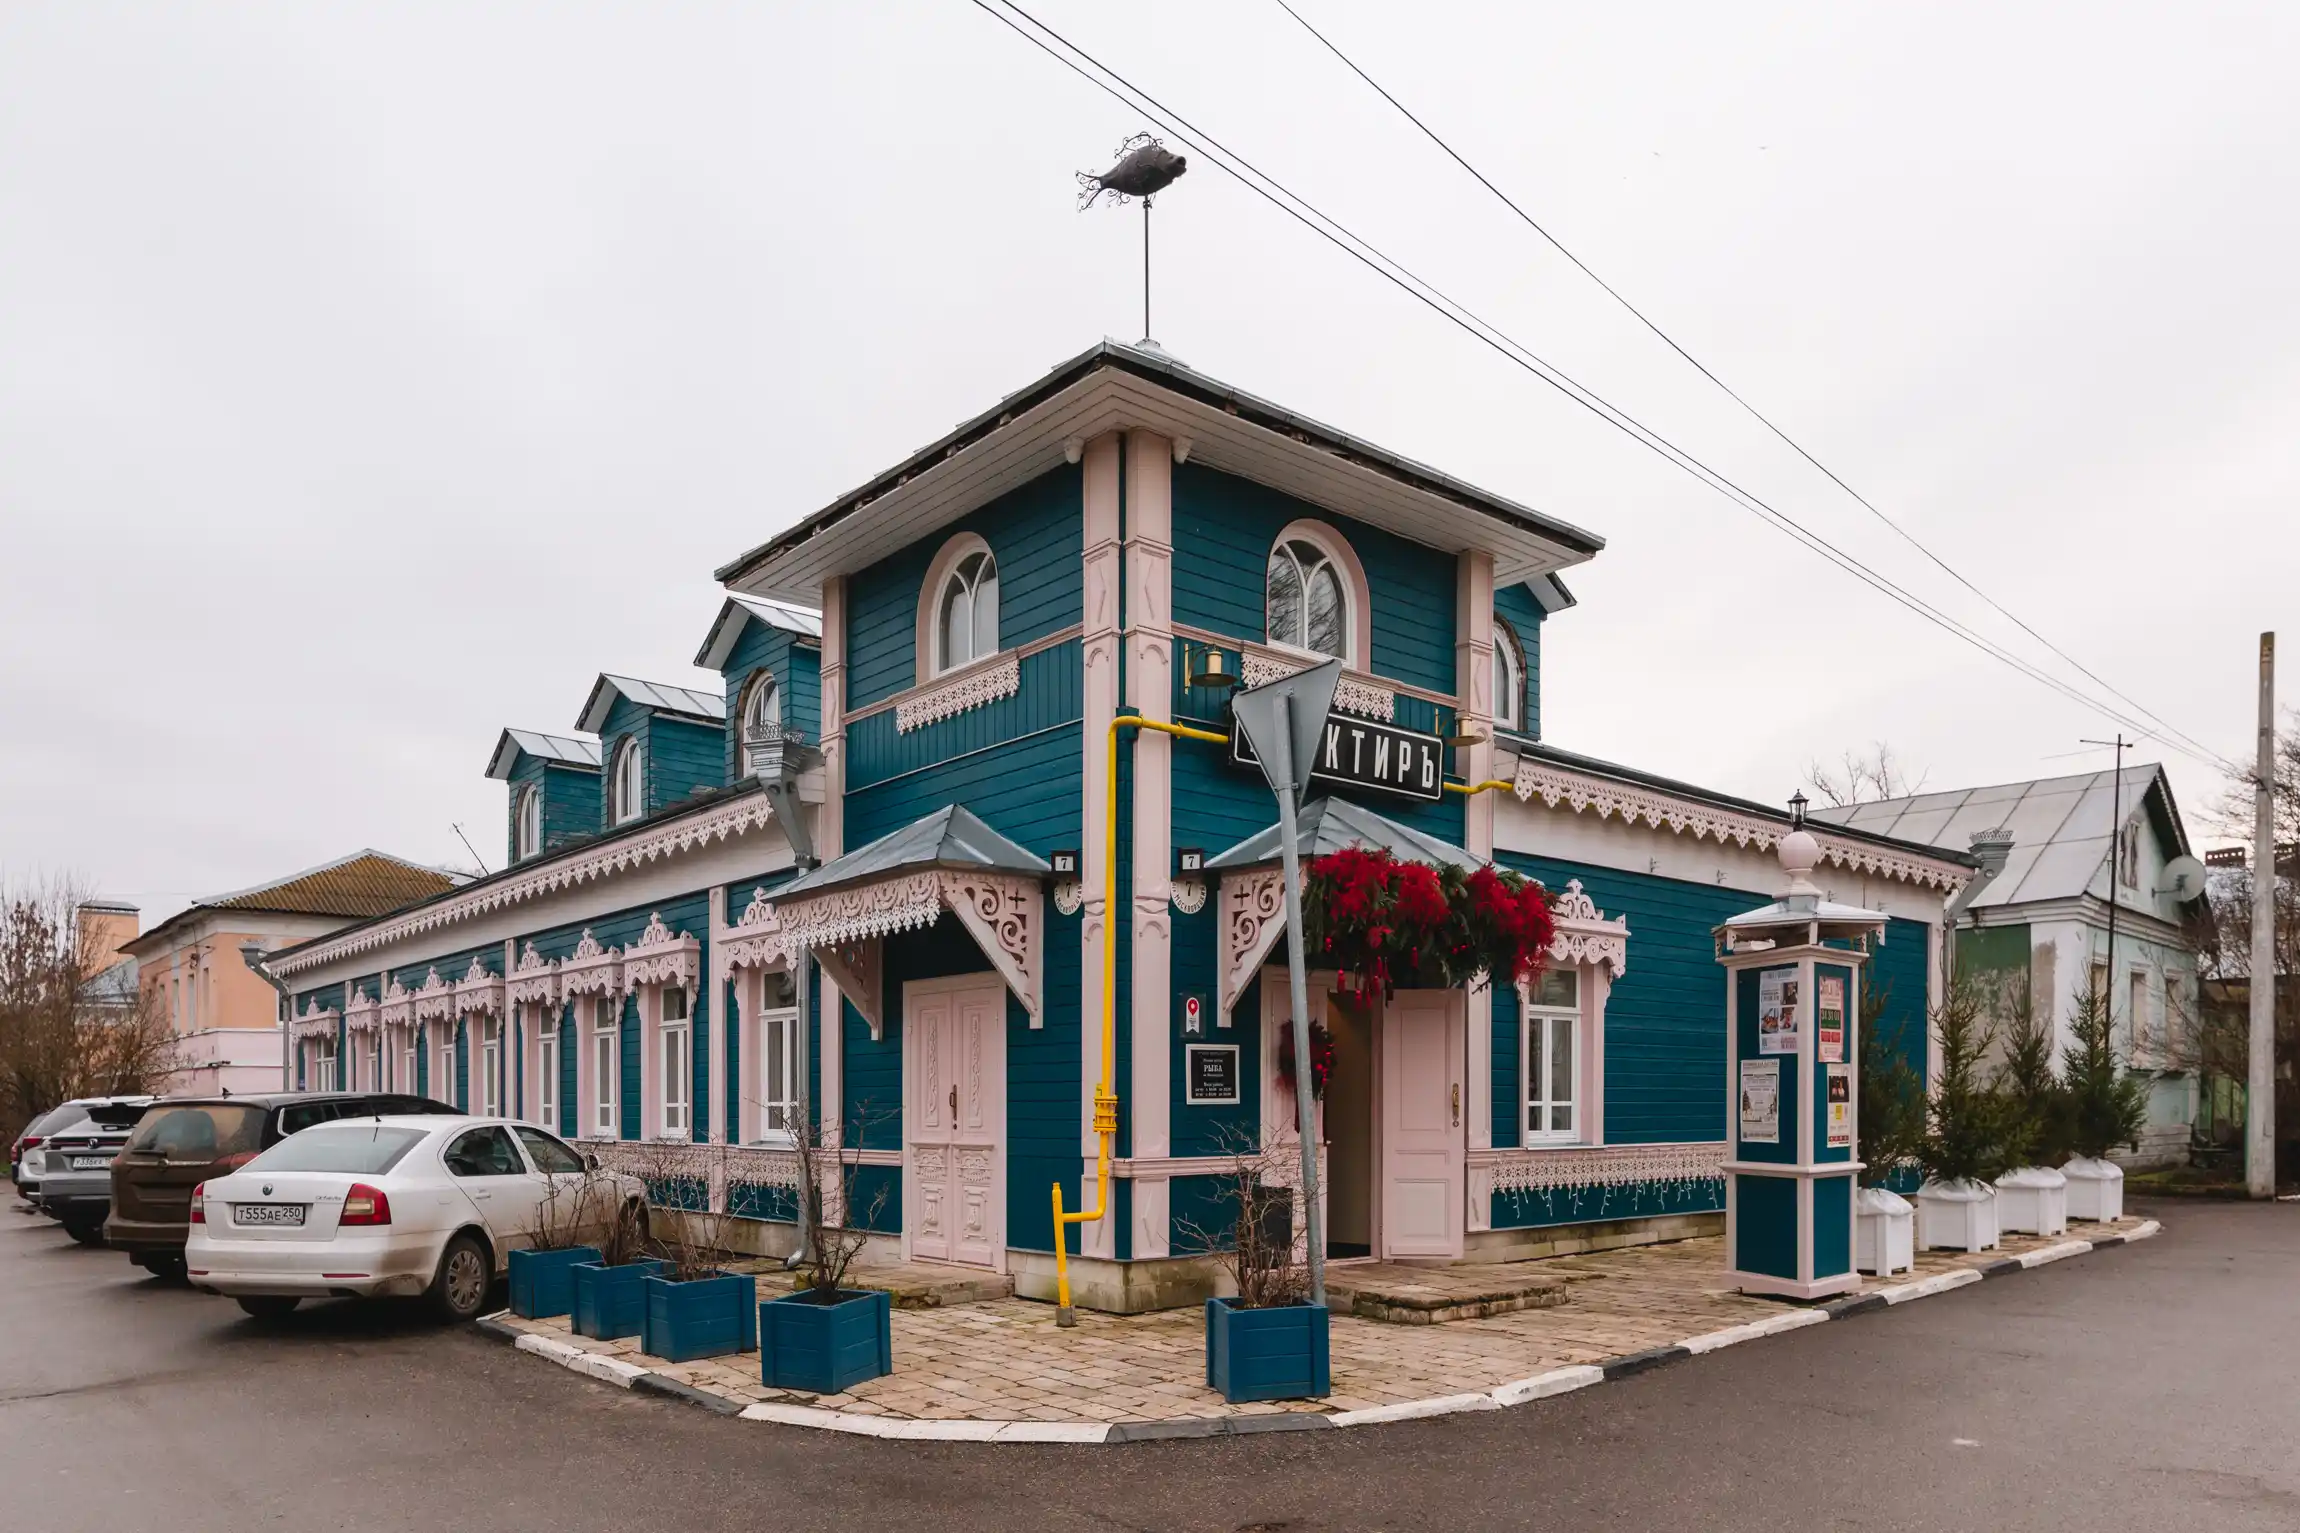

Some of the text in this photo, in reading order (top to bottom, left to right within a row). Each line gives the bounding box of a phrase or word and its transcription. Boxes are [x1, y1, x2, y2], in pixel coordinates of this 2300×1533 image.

[1325, 723, 1434, 789] КТИРЪ
[1061, 858, 1067, 869] 7
[1189, 856, 1194, 867] 7
[1066, 882, 1071, 898] 7
[1186, 880, 1192, 896] 7
[1203, 1064, 1223, 1073] РЫБА
[283, 1207, 301, 1218] 250
